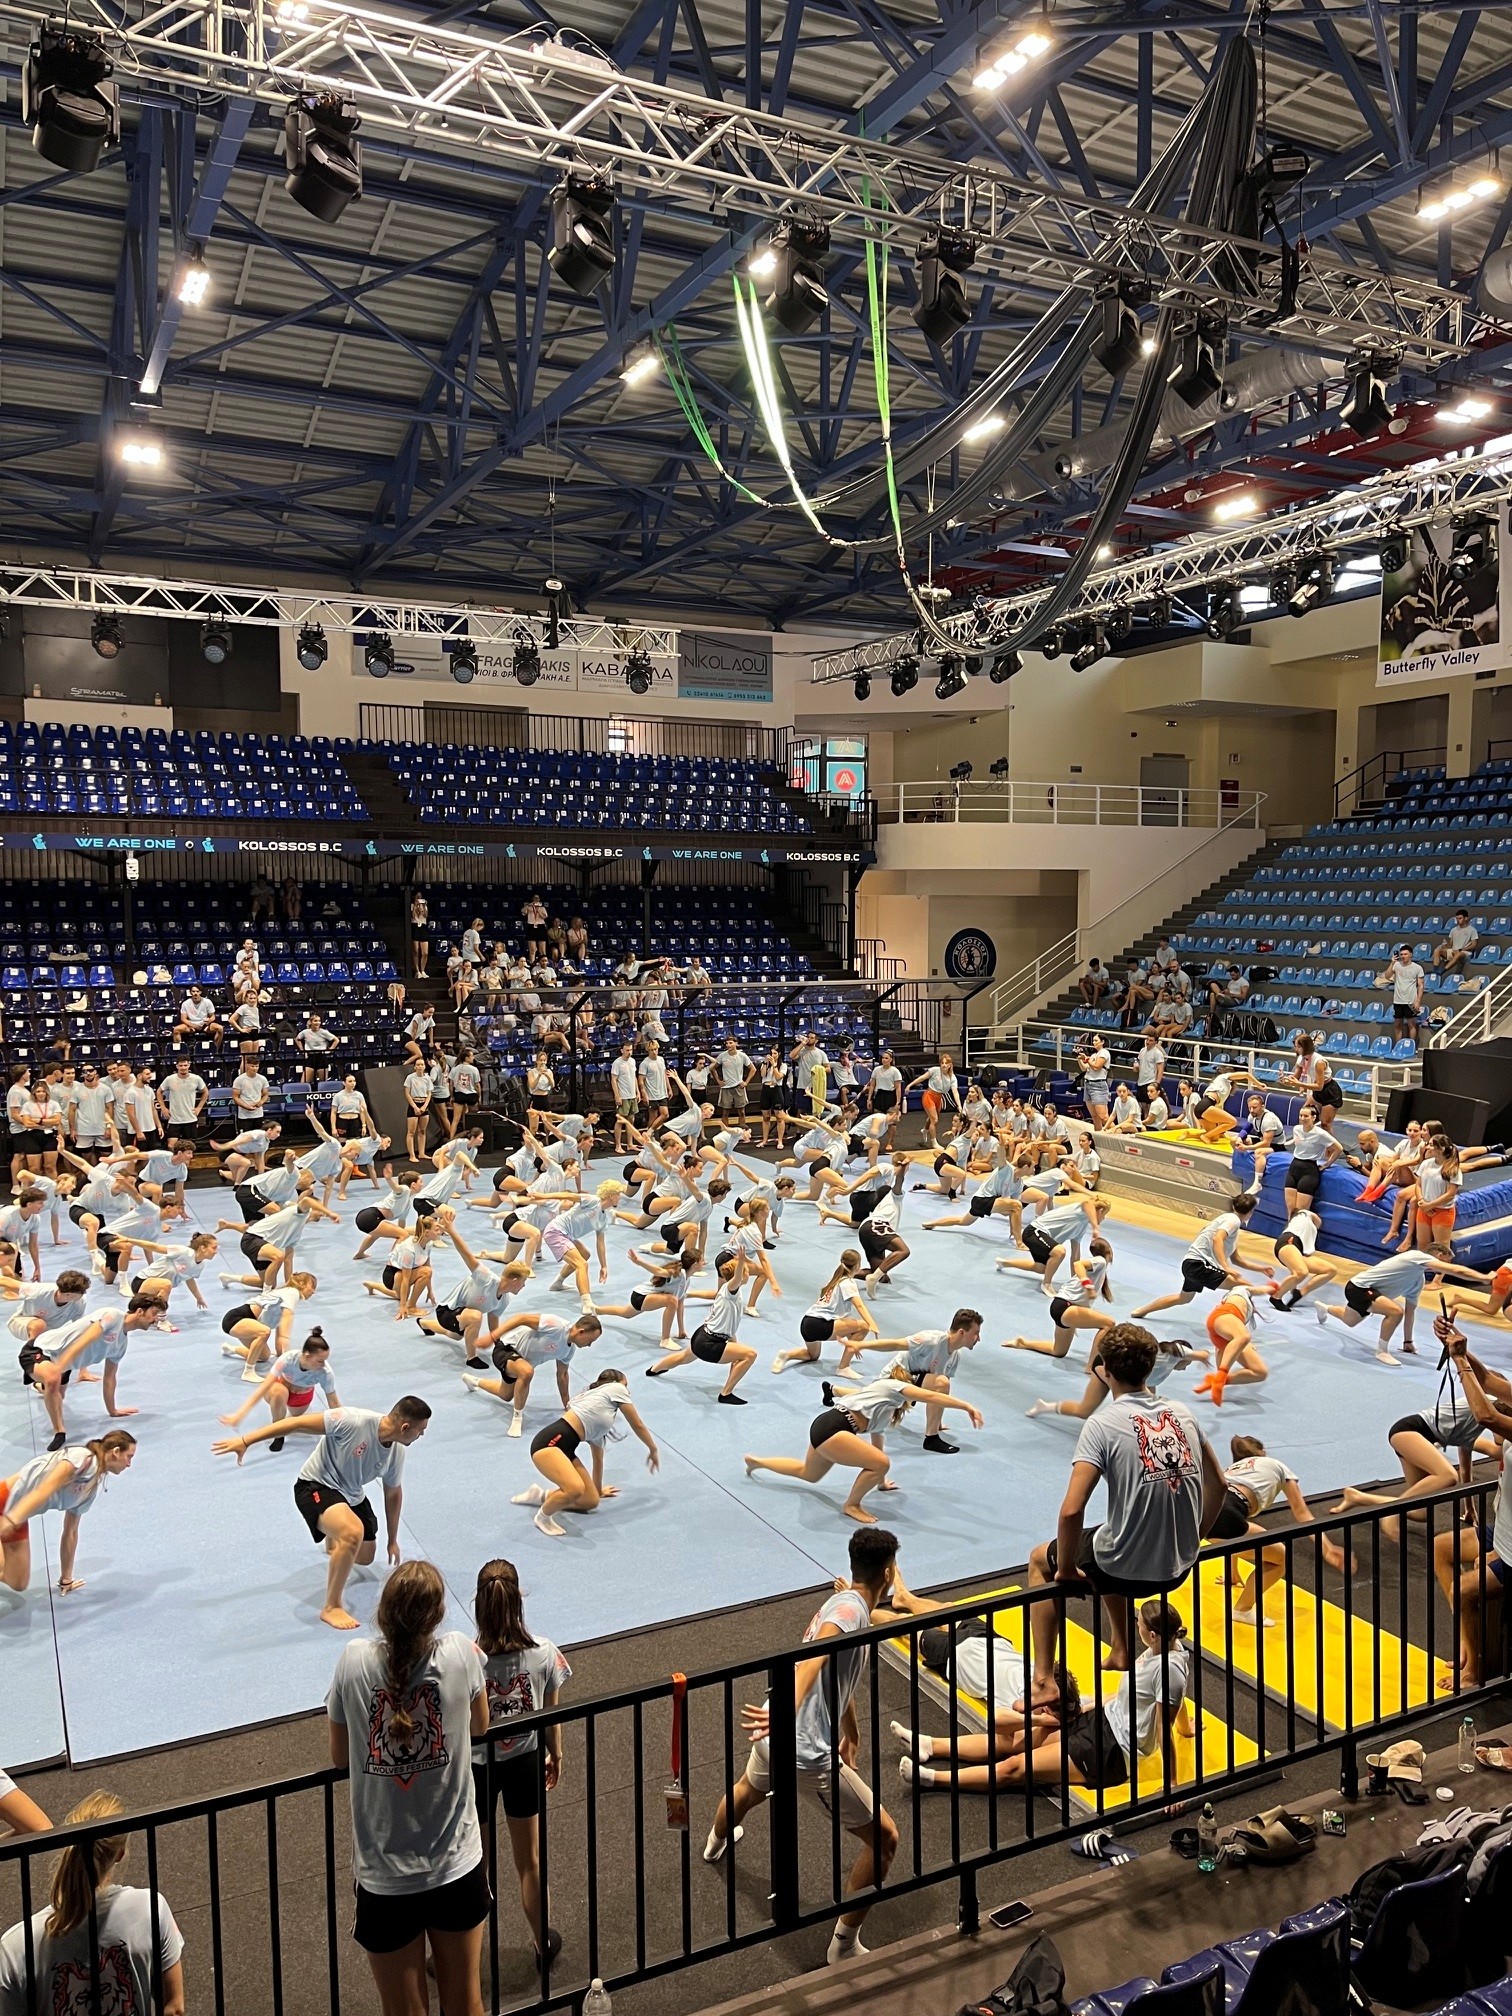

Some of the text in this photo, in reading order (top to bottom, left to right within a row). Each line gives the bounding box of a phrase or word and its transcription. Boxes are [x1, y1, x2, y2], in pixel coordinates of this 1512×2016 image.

[1384, 651, 1480, 675] Butterfly Valley
[70, 687, 128, 698] STRAMATEL
[75, 837, 176, 849] WE ARE ONE
[238, 840, 342, 852] KOLOSSOS B.C
[401, 844, 484, 854] WE ARE ONE
[536, 846, 623, 857] KOLOSSOS B.C
[672, 850, 742, 860] WE ARE ONE
[786, 852, 860, 861] KOLOSSOS B.C
[372, 1757, 444, 1774] WOLVES FESTIVAL
